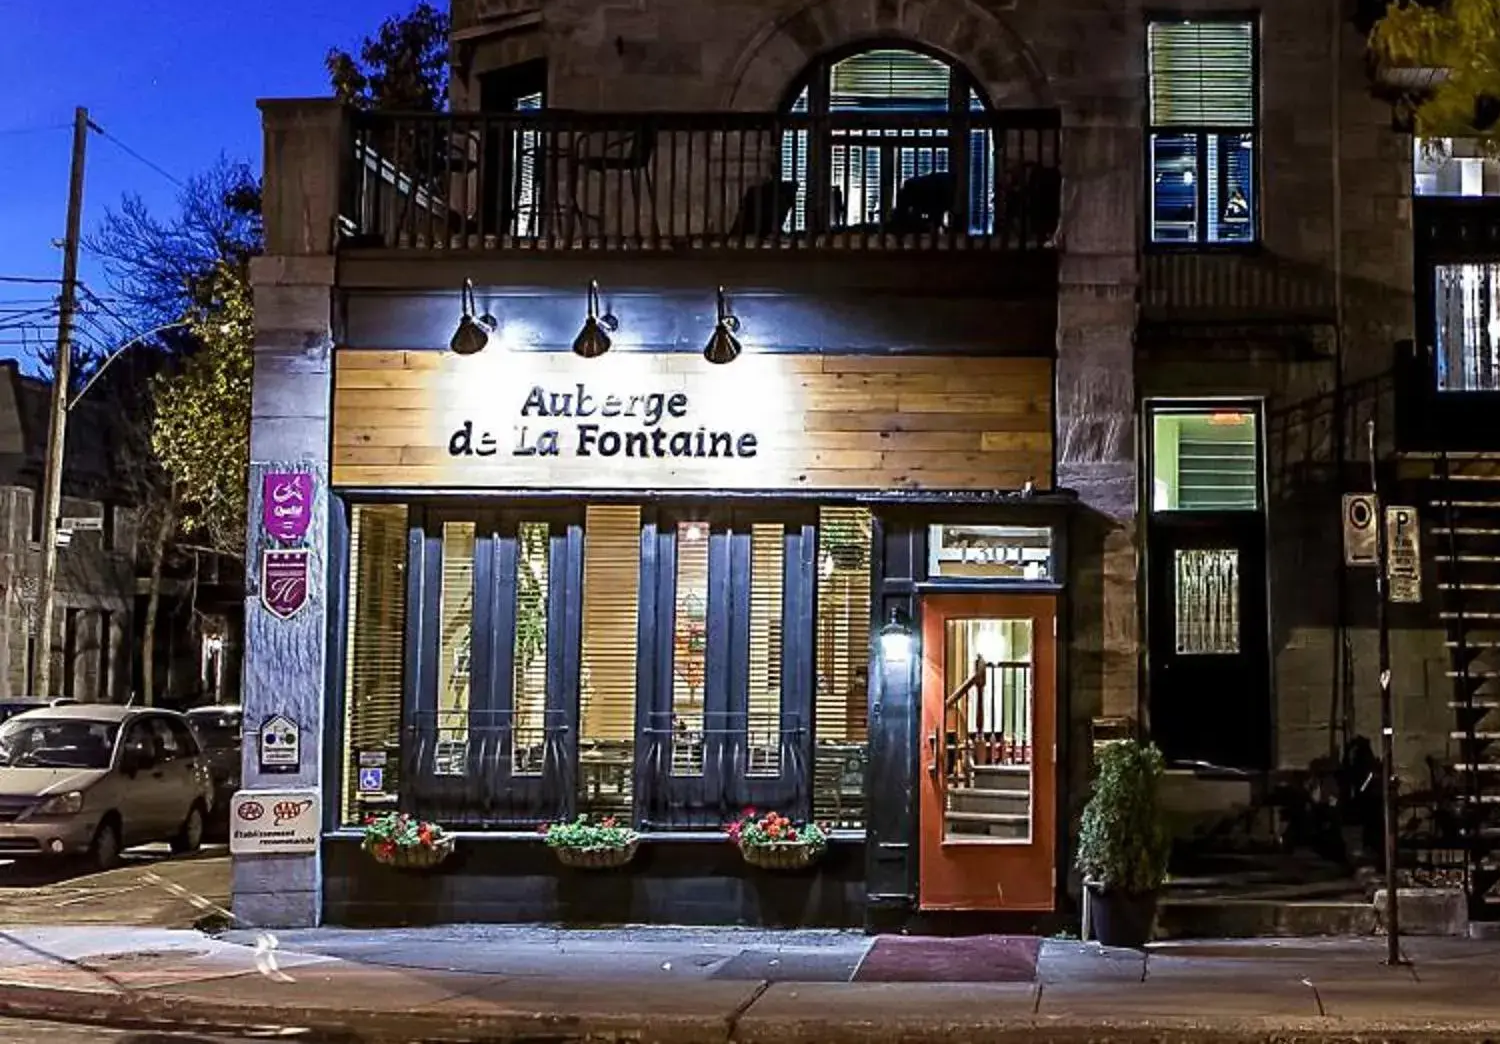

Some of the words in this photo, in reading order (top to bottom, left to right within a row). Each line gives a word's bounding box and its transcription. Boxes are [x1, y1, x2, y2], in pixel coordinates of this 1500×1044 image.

[520, 383, 688, 426] Auberge
[448, 421, 496, 456] de
[512, 426, 560, 456] La
[576, 423, 757, 457] Fontaine
[1396, 511, 1409, 534] P
[951, 539, 1024, 565] 1301
